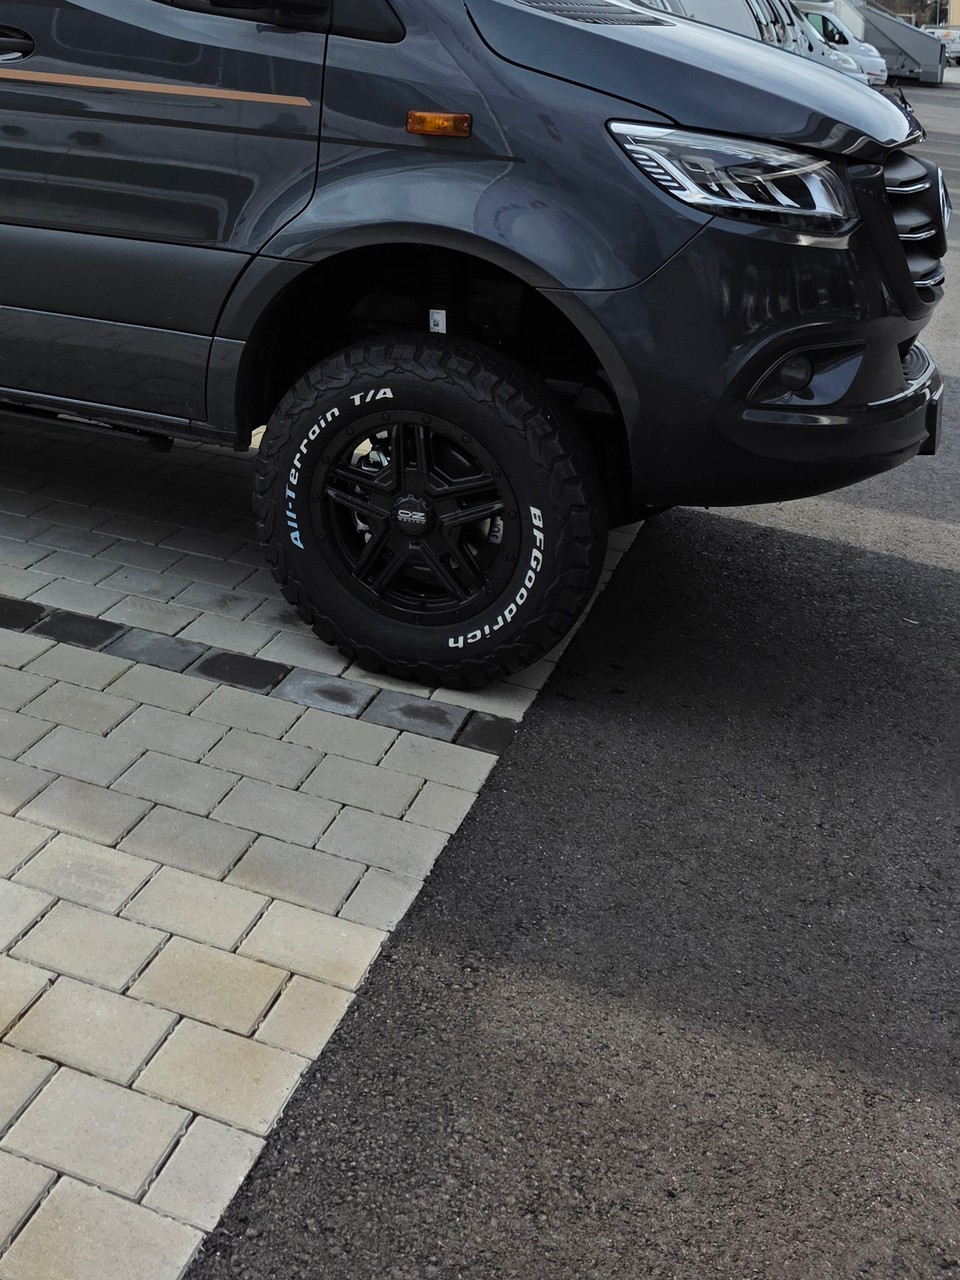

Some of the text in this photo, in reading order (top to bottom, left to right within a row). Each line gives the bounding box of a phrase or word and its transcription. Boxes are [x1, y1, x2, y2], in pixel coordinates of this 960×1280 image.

[285, 387, 394, 550] All-Terrain T/A
[448, 505, 544, 648] BFGoodrich
